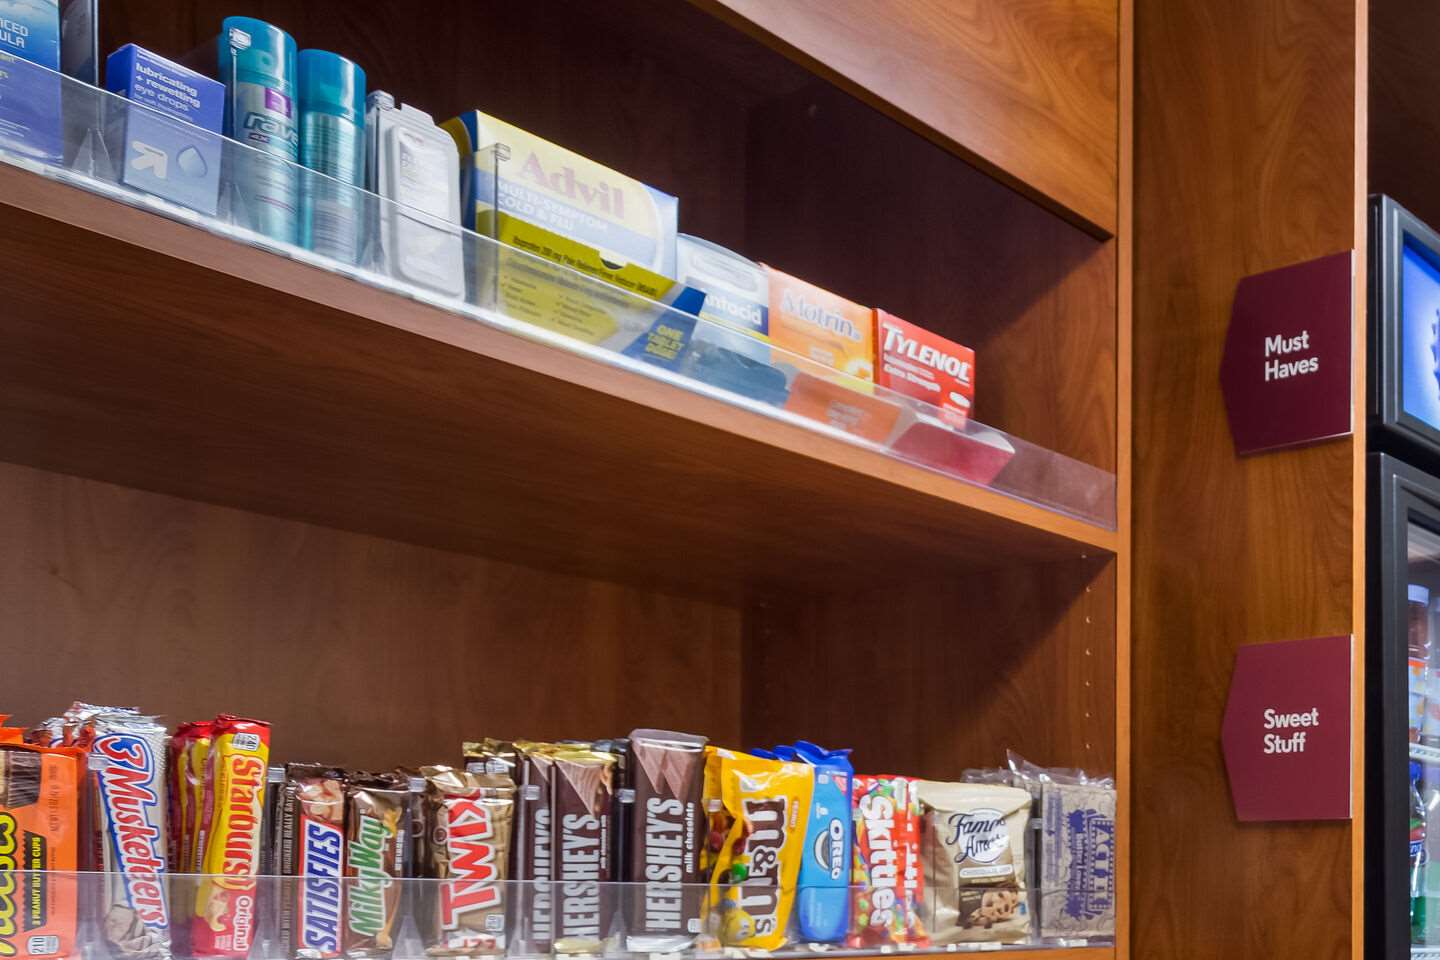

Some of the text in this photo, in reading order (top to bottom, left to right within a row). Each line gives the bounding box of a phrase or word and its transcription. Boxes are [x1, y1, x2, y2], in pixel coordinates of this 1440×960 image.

[134, 83, 190, 113] eye drops
[135, 62, 198, 97] lubricating
[521, 151, 625, 220] Advil
[882, 322, 972, 381] TYLENOL
[1265, 330, 1310, 357] Must
[1265, 357, 1319, 381] Haves
[1264, 707, 1319, 729] Sweet
[1264, 731, 1306, 754] Stuff
[98, 737, 166, 926] 3 Musketeers
[686, 802, 696, 850] chocolate
[830, 819, 845, 880] OREO
[1094, 828, 1111, 872] ACT
[304, 823, 342, 952] SATISFIES
[562, 814, 600, 939] HERSHEY'S
[645, 798, 684, 930] HERSHEY'S
[859, 794, 897, 928] Skittles
[234, 895, 252, 952] Original
